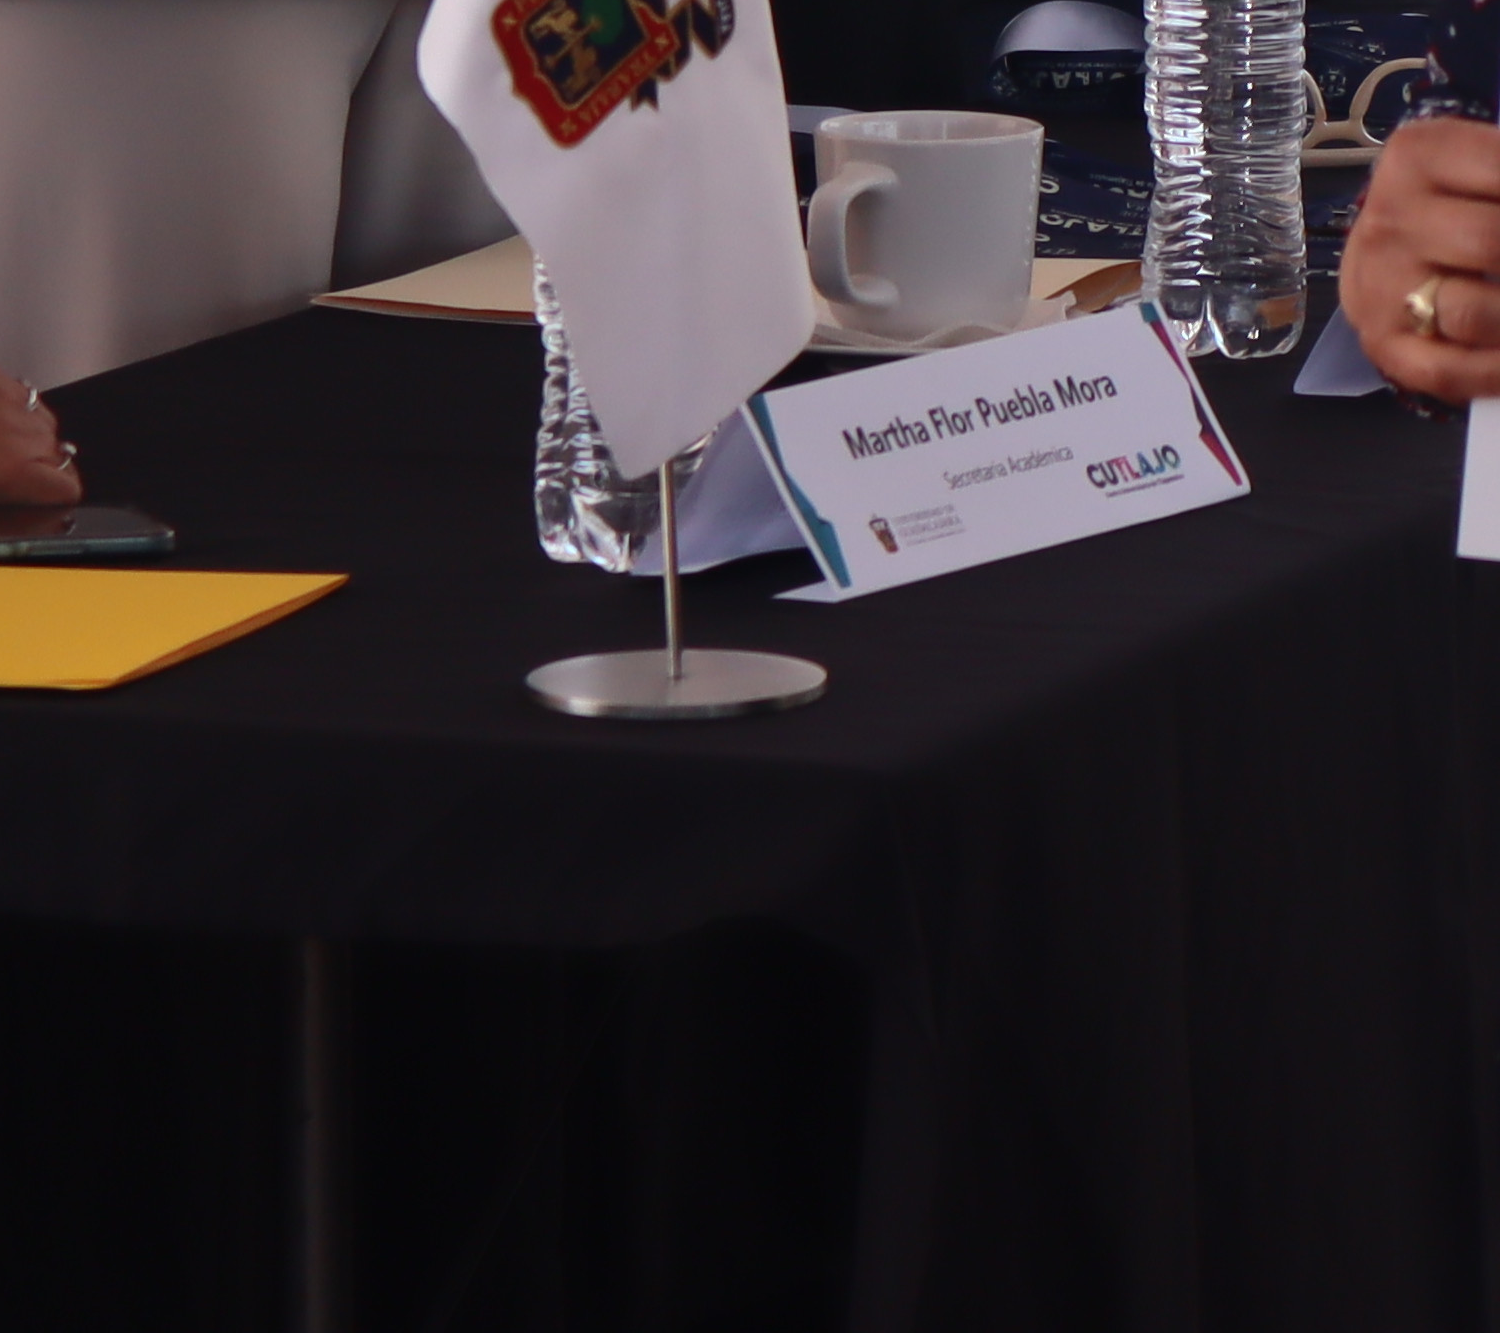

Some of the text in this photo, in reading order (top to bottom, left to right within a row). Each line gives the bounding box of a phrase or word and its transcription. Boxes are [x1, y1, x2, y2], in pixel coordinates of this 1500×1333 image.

[842, 374, 1118, 459] Martha Flor Puebla Mora
[1086, 444, 1181, 488] CUTLAJO
